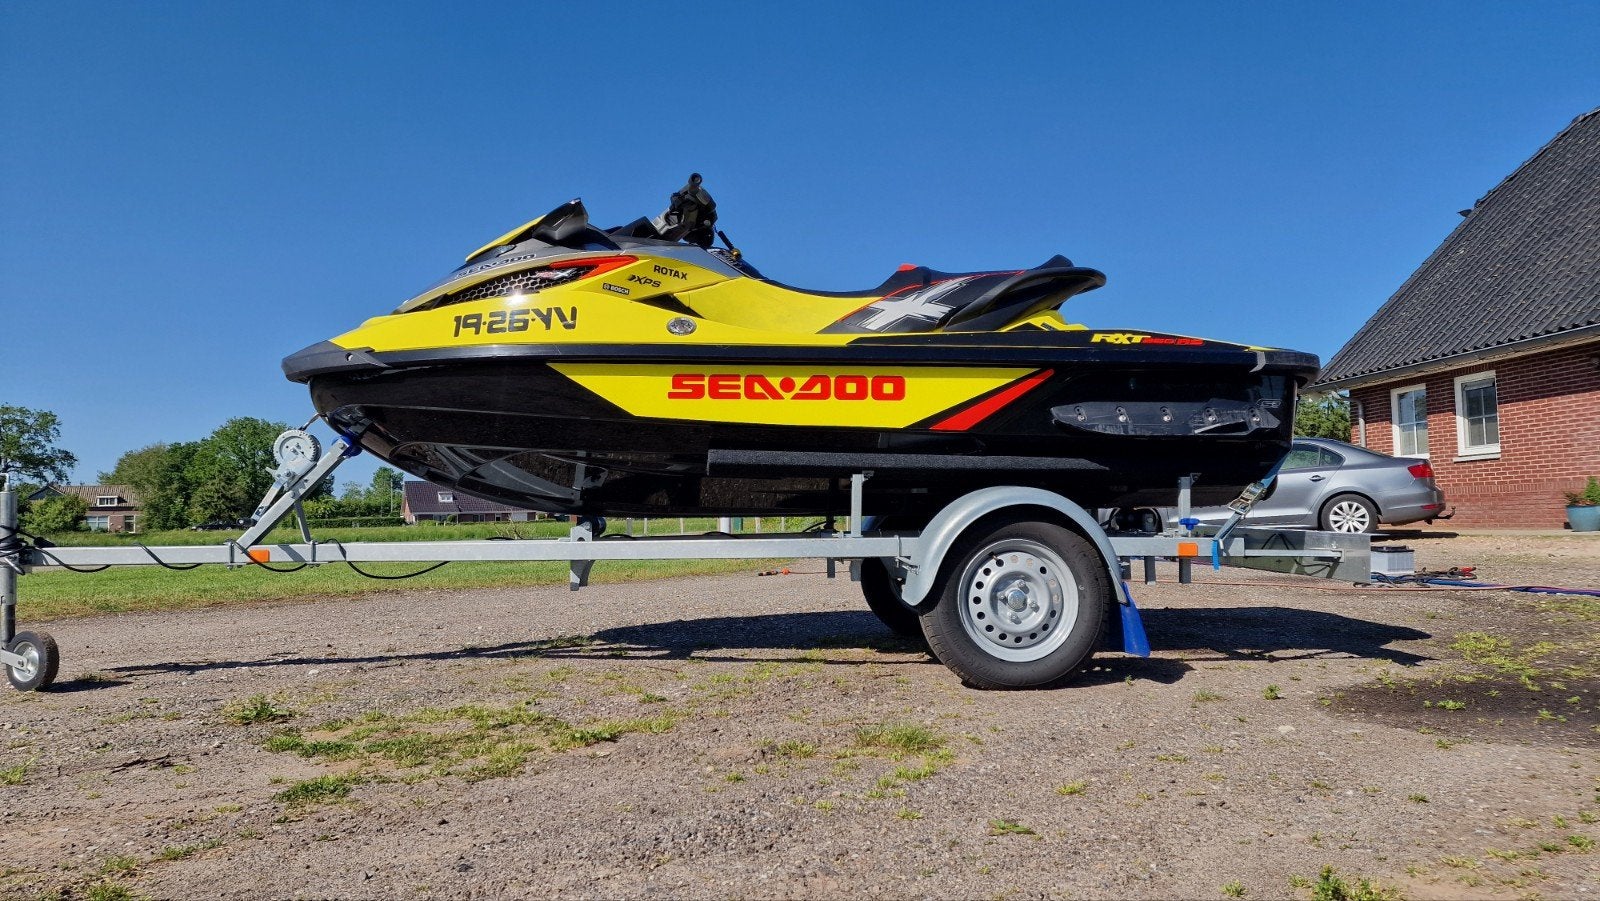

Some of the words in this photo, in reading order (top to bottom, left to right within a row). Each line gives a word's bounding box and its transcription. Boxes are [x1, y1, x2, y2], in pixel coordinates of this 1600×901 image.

[653, 264, 688, 281] ROTAX
[635, 275, 662, 288] XPS
[610, 285, 630, 295] BOSCH
[1090, 332, 1152, 345] RXT
